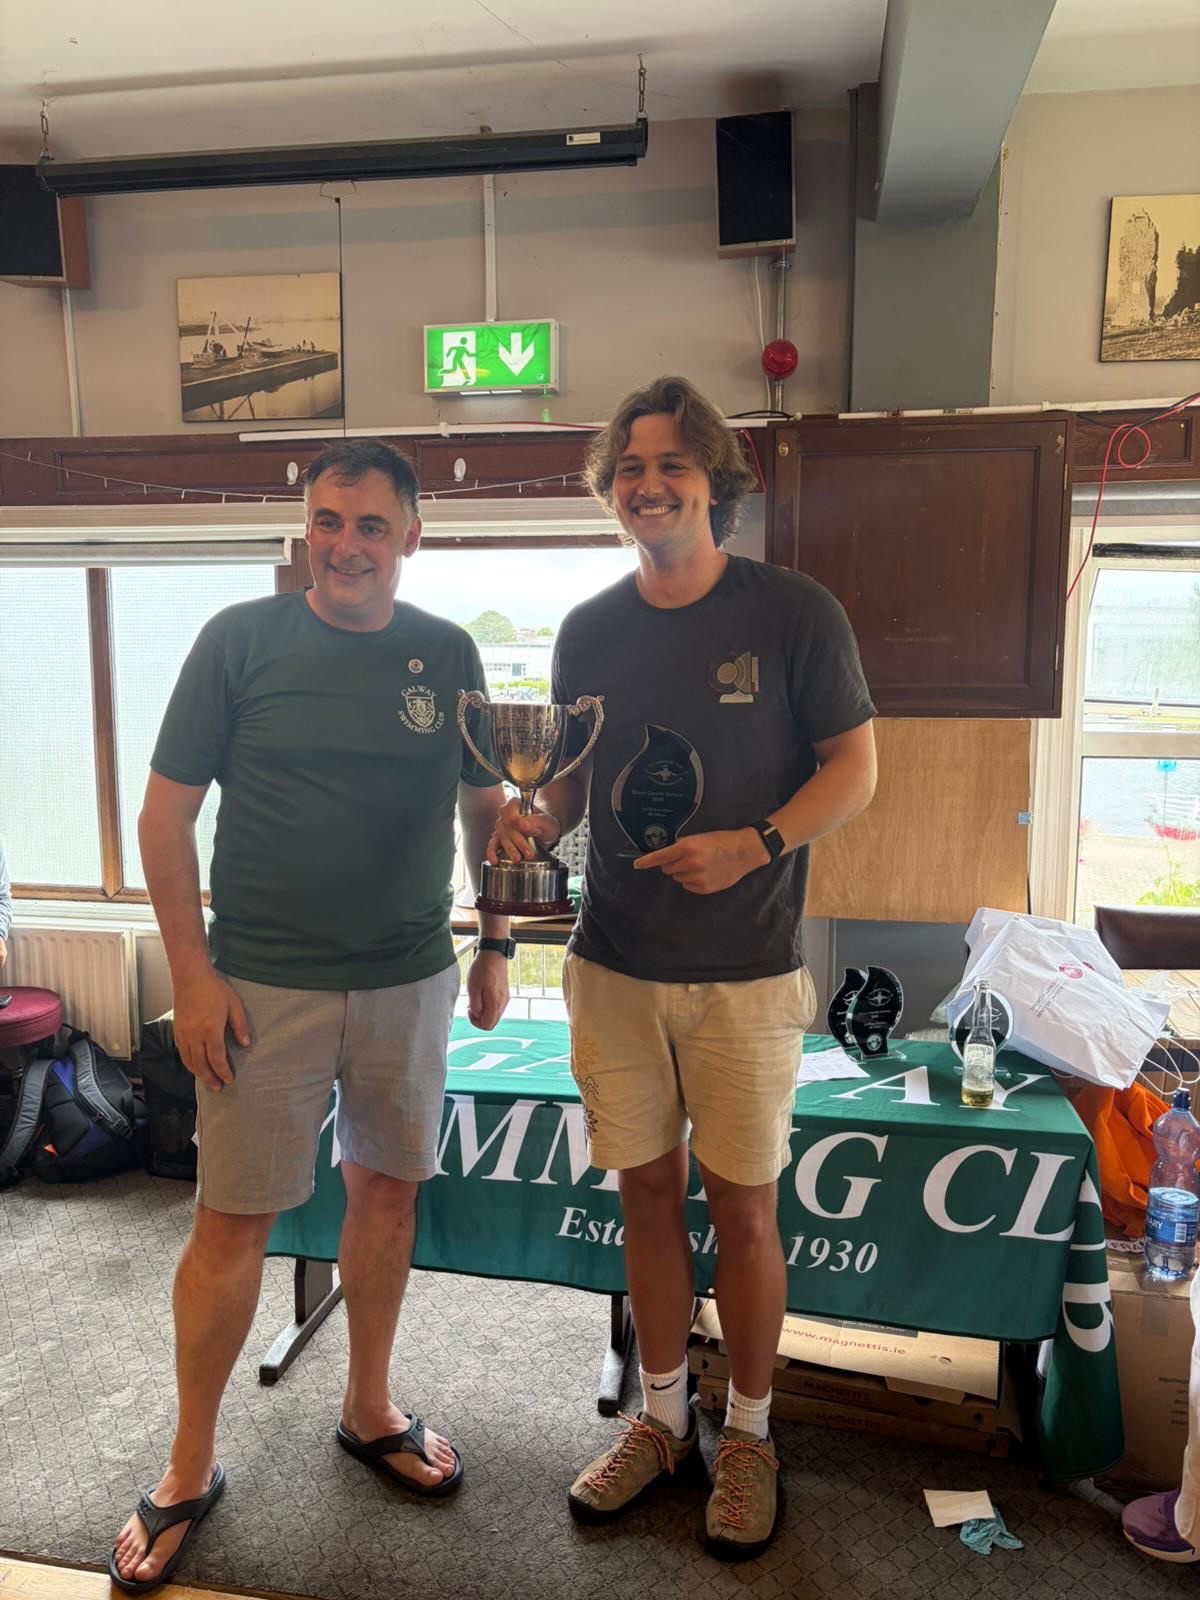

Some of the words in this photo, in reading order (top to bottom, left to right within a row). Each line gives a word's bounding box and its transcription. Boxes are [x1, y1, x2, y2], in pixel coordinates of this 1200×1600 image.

[401, 684, 437, 697] GALWAY
[397, 709, 436, 735] SWIMMING
[786, 1235, 879, 1275] 1930
[781, 1327, 906, 1356] www.magnettis.ie
